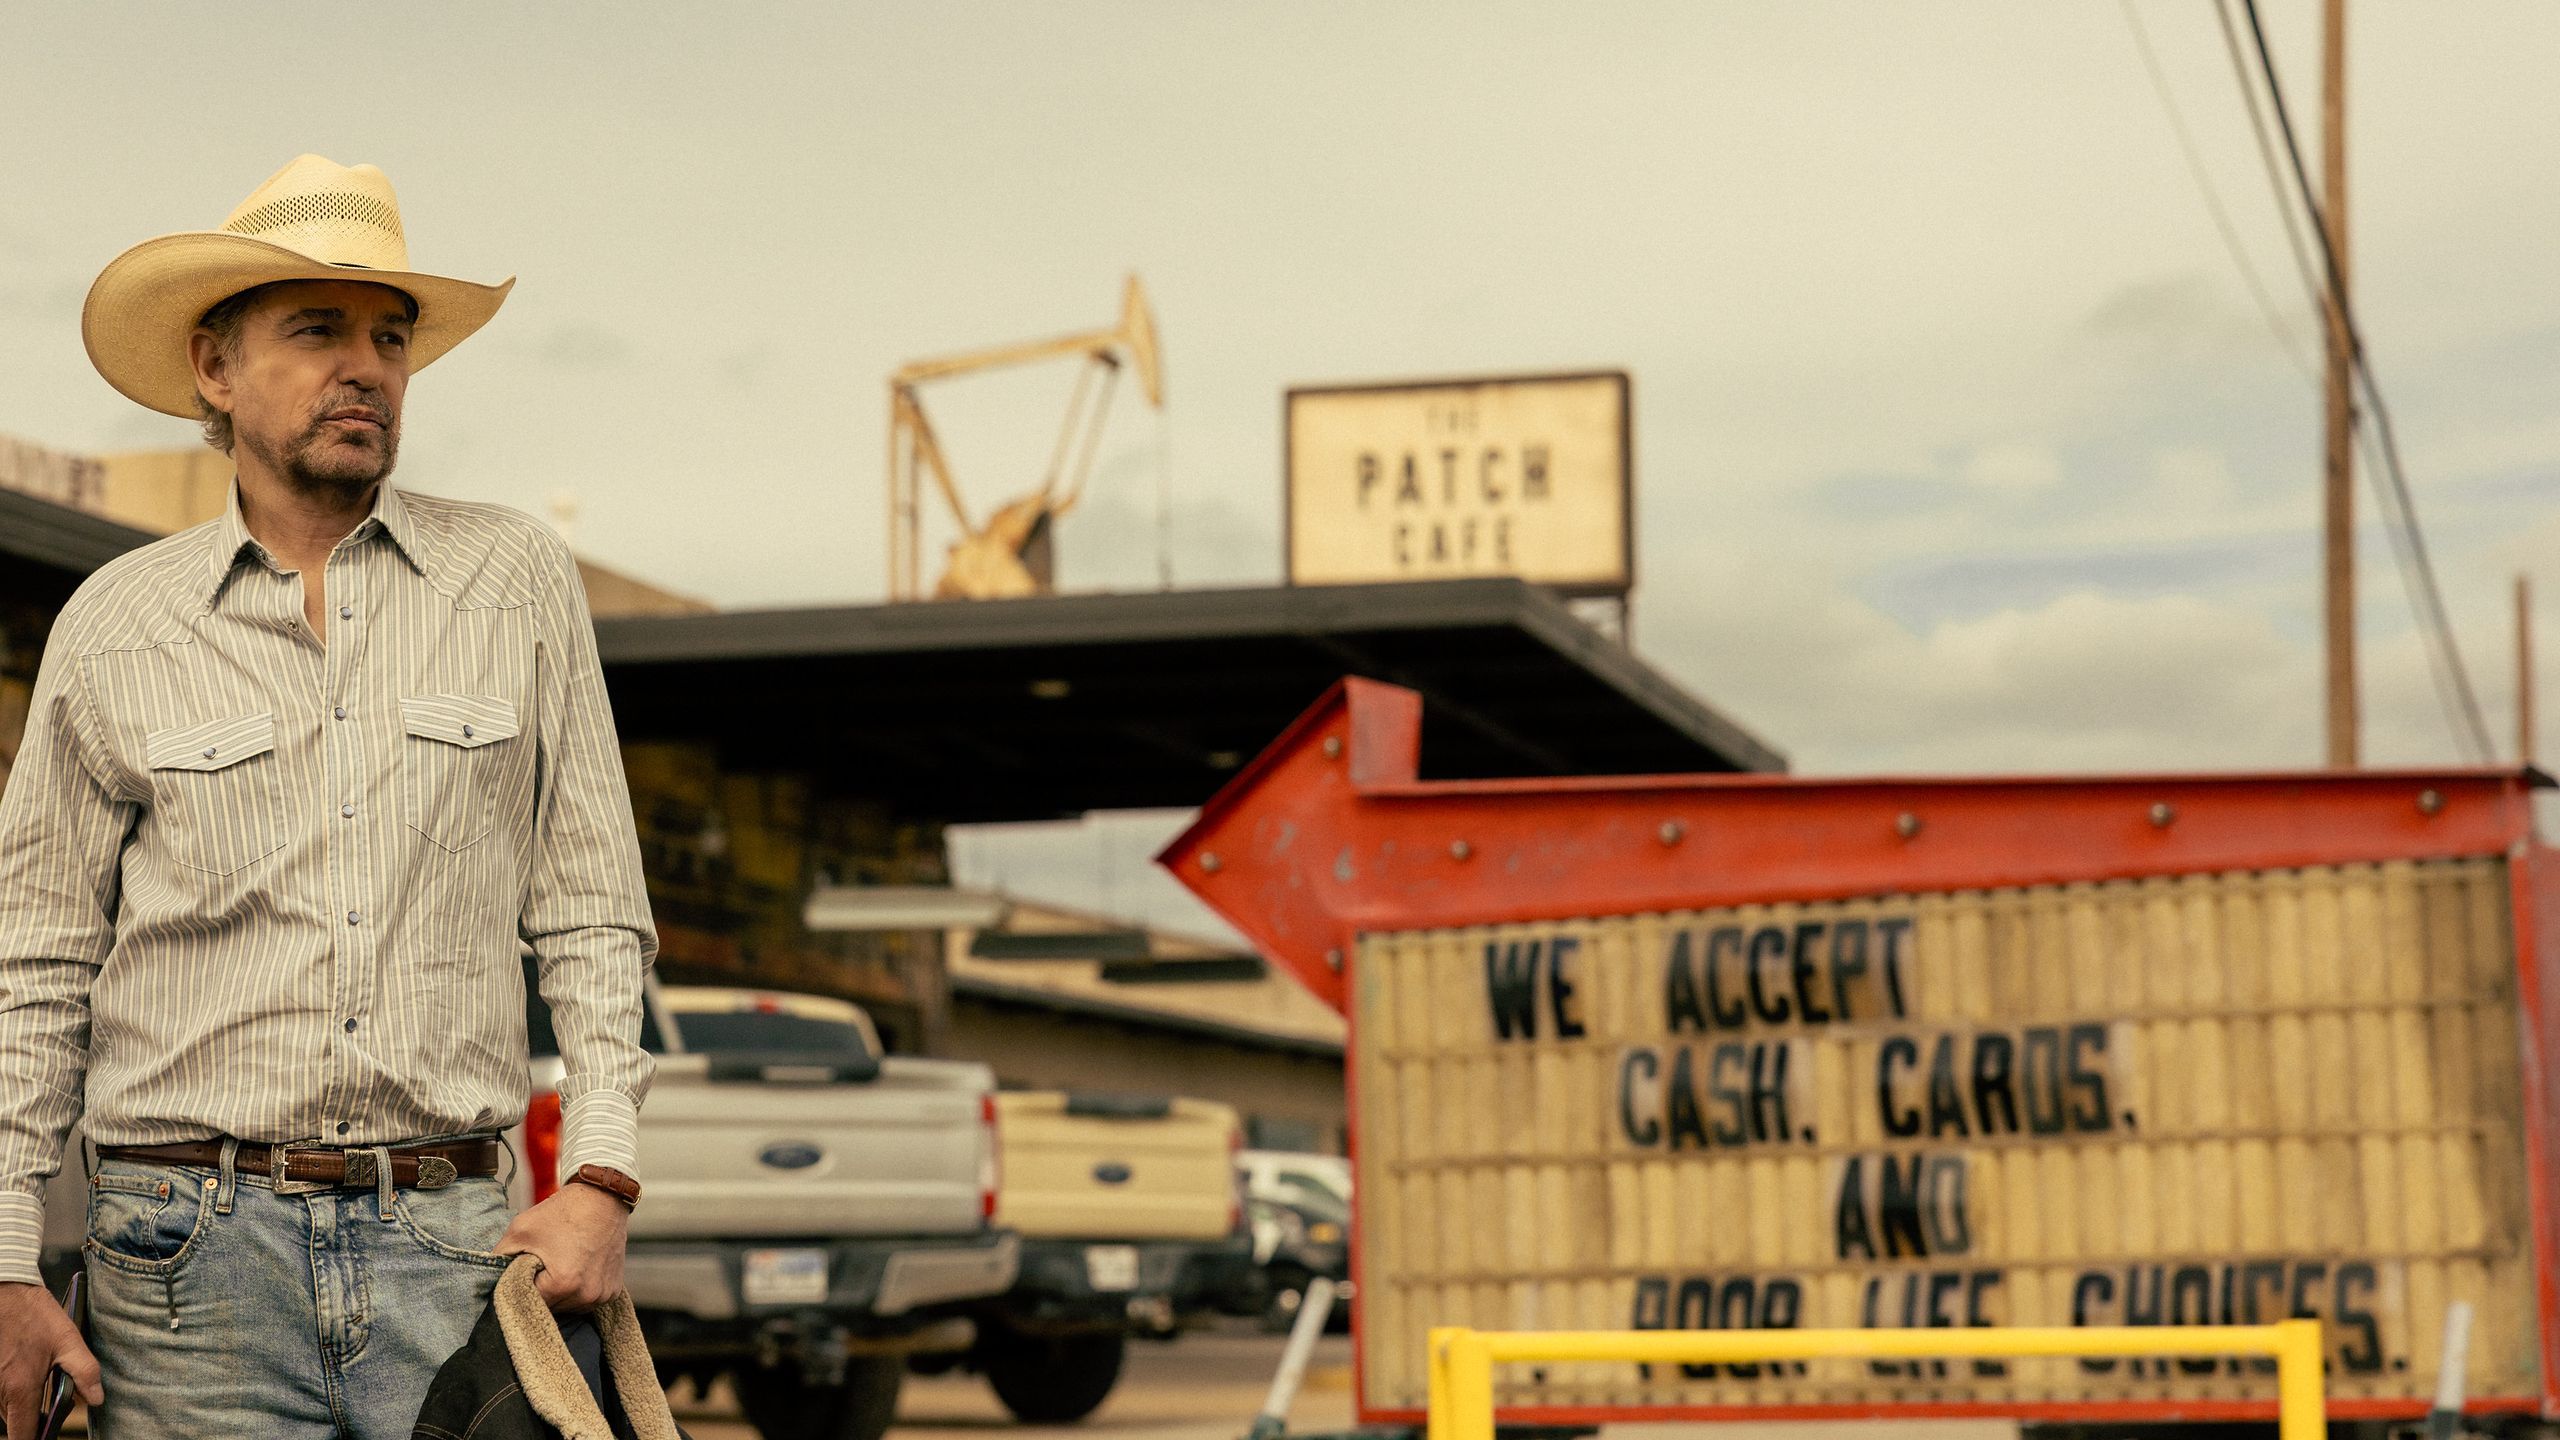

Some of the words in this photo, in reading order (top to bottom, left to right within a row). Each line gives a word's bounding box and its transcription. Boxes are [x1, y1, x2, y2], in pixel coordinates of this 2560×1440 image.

[1357, 442, 1550, 512] PATCH
[1394, 515, 1512, 567] CAFE
[1485, 938, 1585, 1040] WE
[1665, 917, 1912, 1034] ACCEPT
[1837, 1153, 1970, 1261] AND
[1632, 1273, 1806, 1380] POOR
[1864, 1269, 2004, 1377] LIFE
